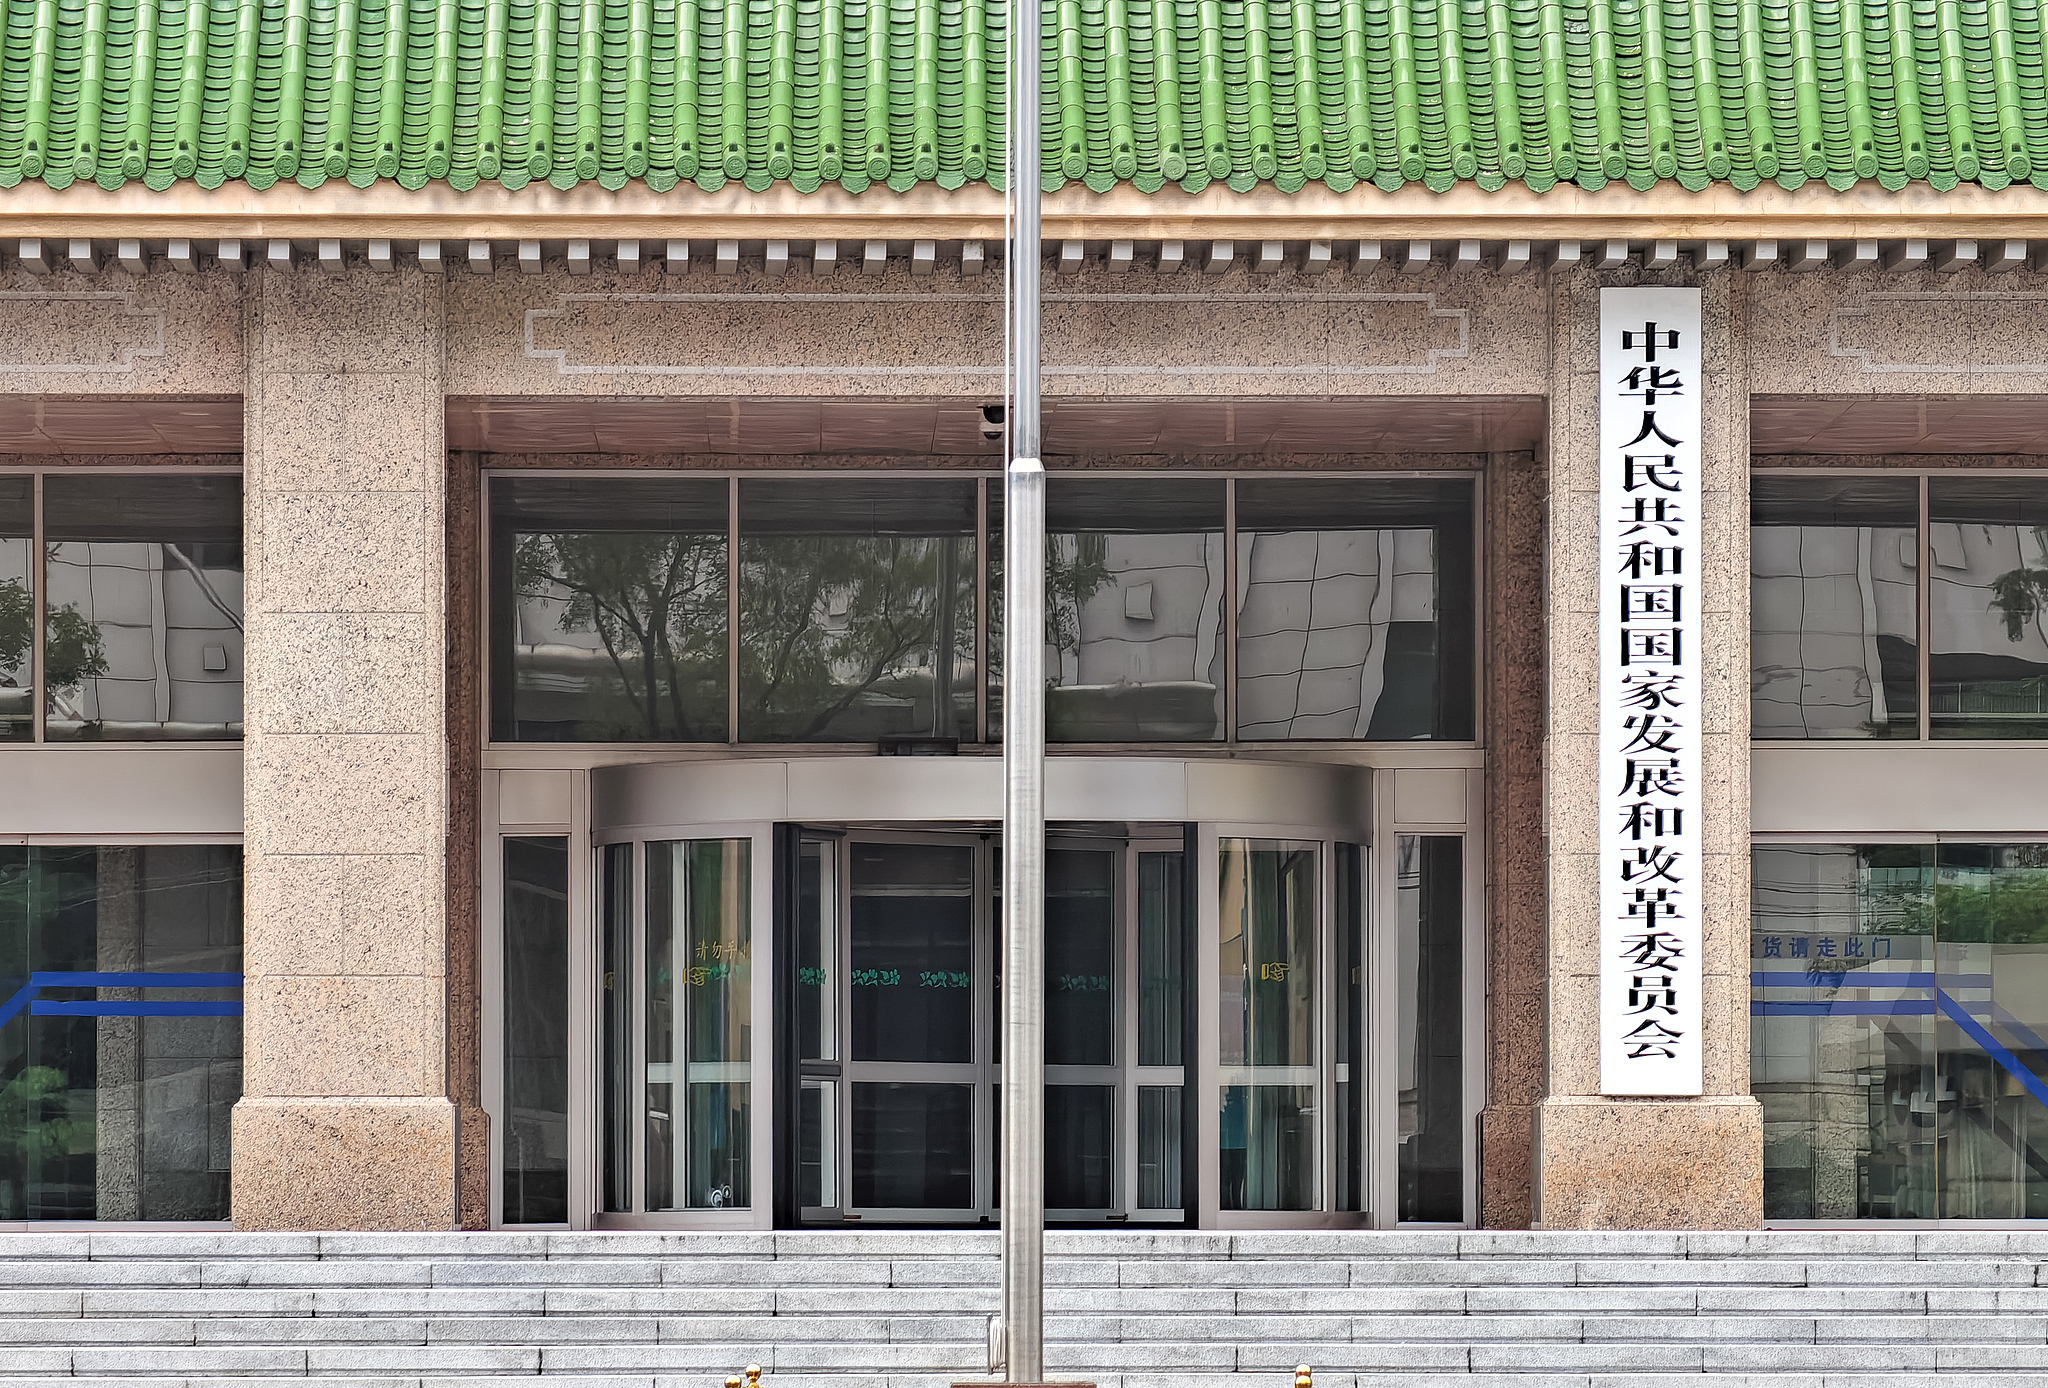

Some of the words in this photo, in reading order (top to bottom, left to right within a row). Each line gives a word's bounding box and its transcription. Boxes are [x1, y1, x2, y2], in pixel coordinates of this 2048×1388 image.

[1618, 321, 1685, 1059] 中华人民共和国国家发展和改革委员会
[1751, 936, 1891, 958] 货请走此门
